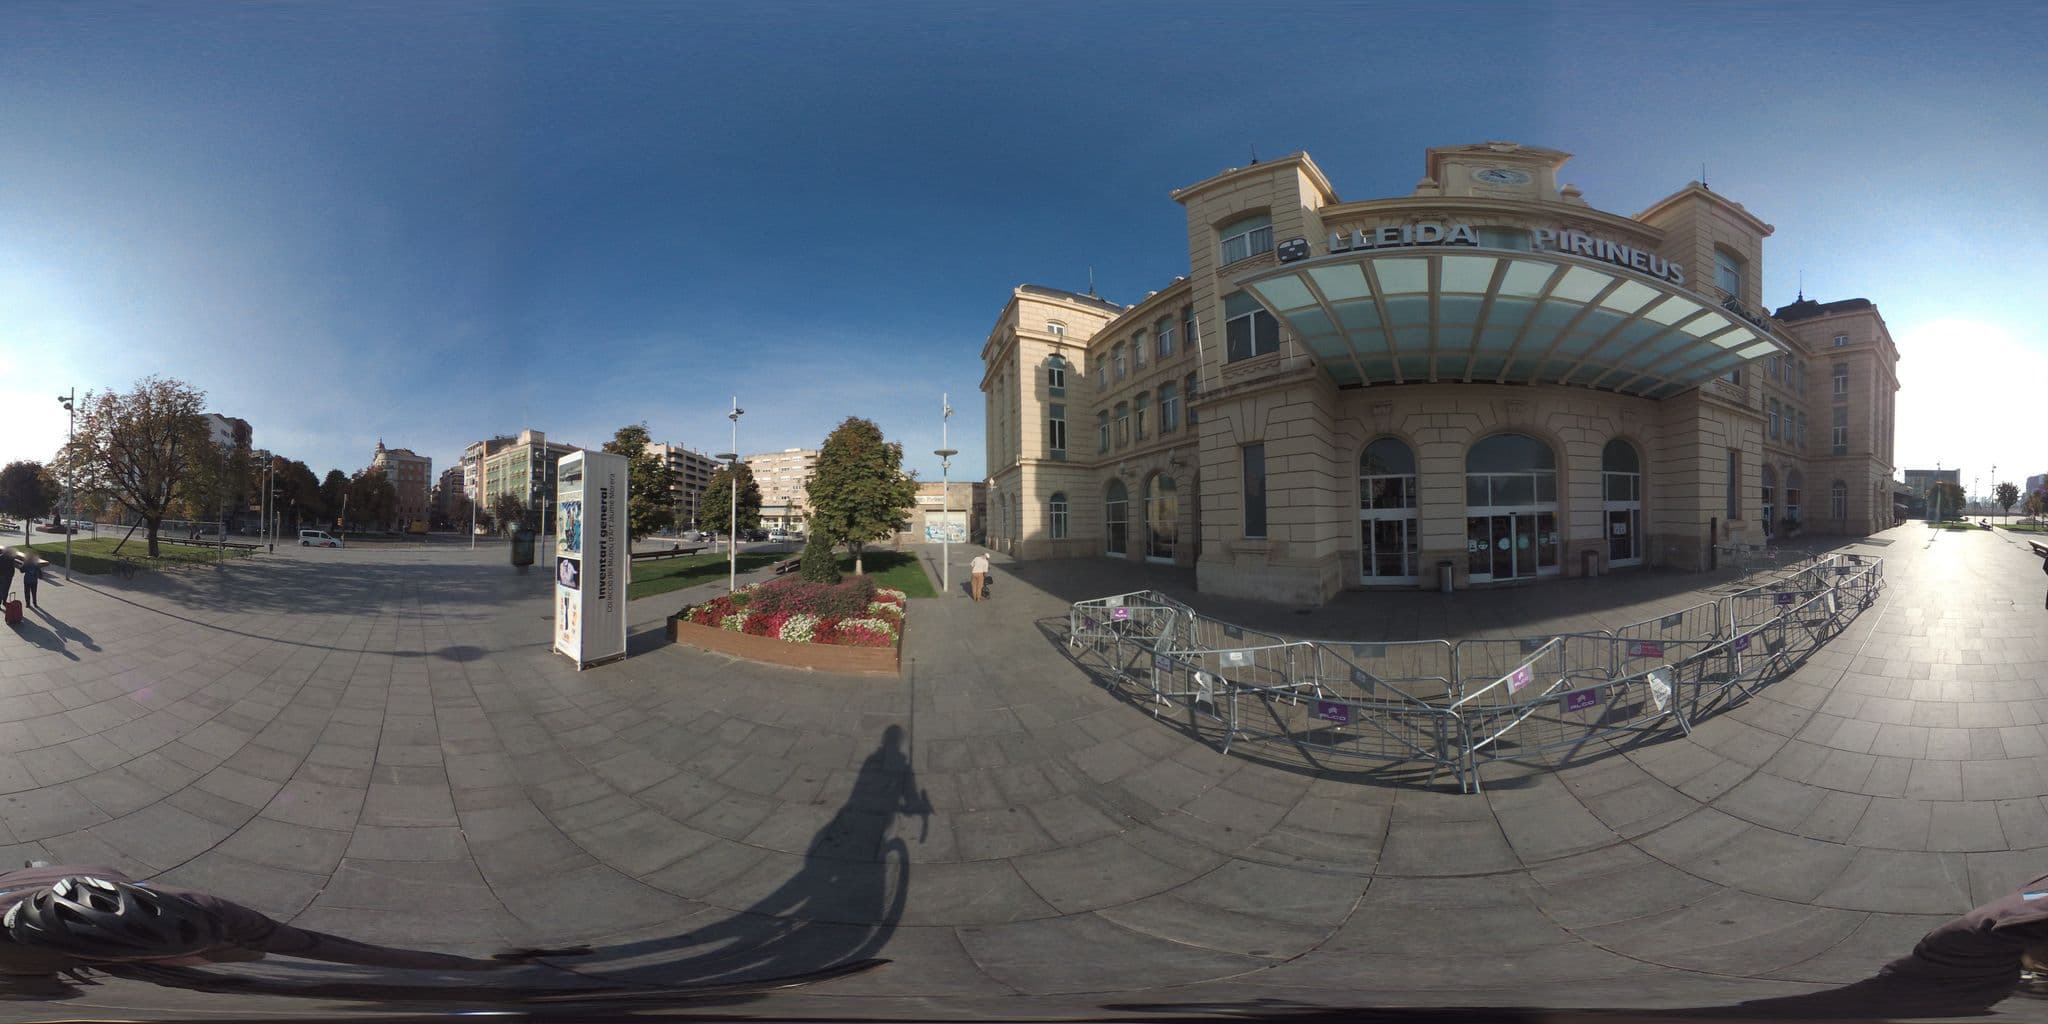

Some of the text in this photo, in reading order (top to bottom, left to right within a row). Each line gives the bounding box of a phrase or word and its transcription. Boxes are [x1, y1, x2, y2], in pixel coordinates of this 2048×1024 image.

[1329, 224, 1685, 285] LLEIDA PIRINEUS
[598, 487, 608, 600] Inventari general
